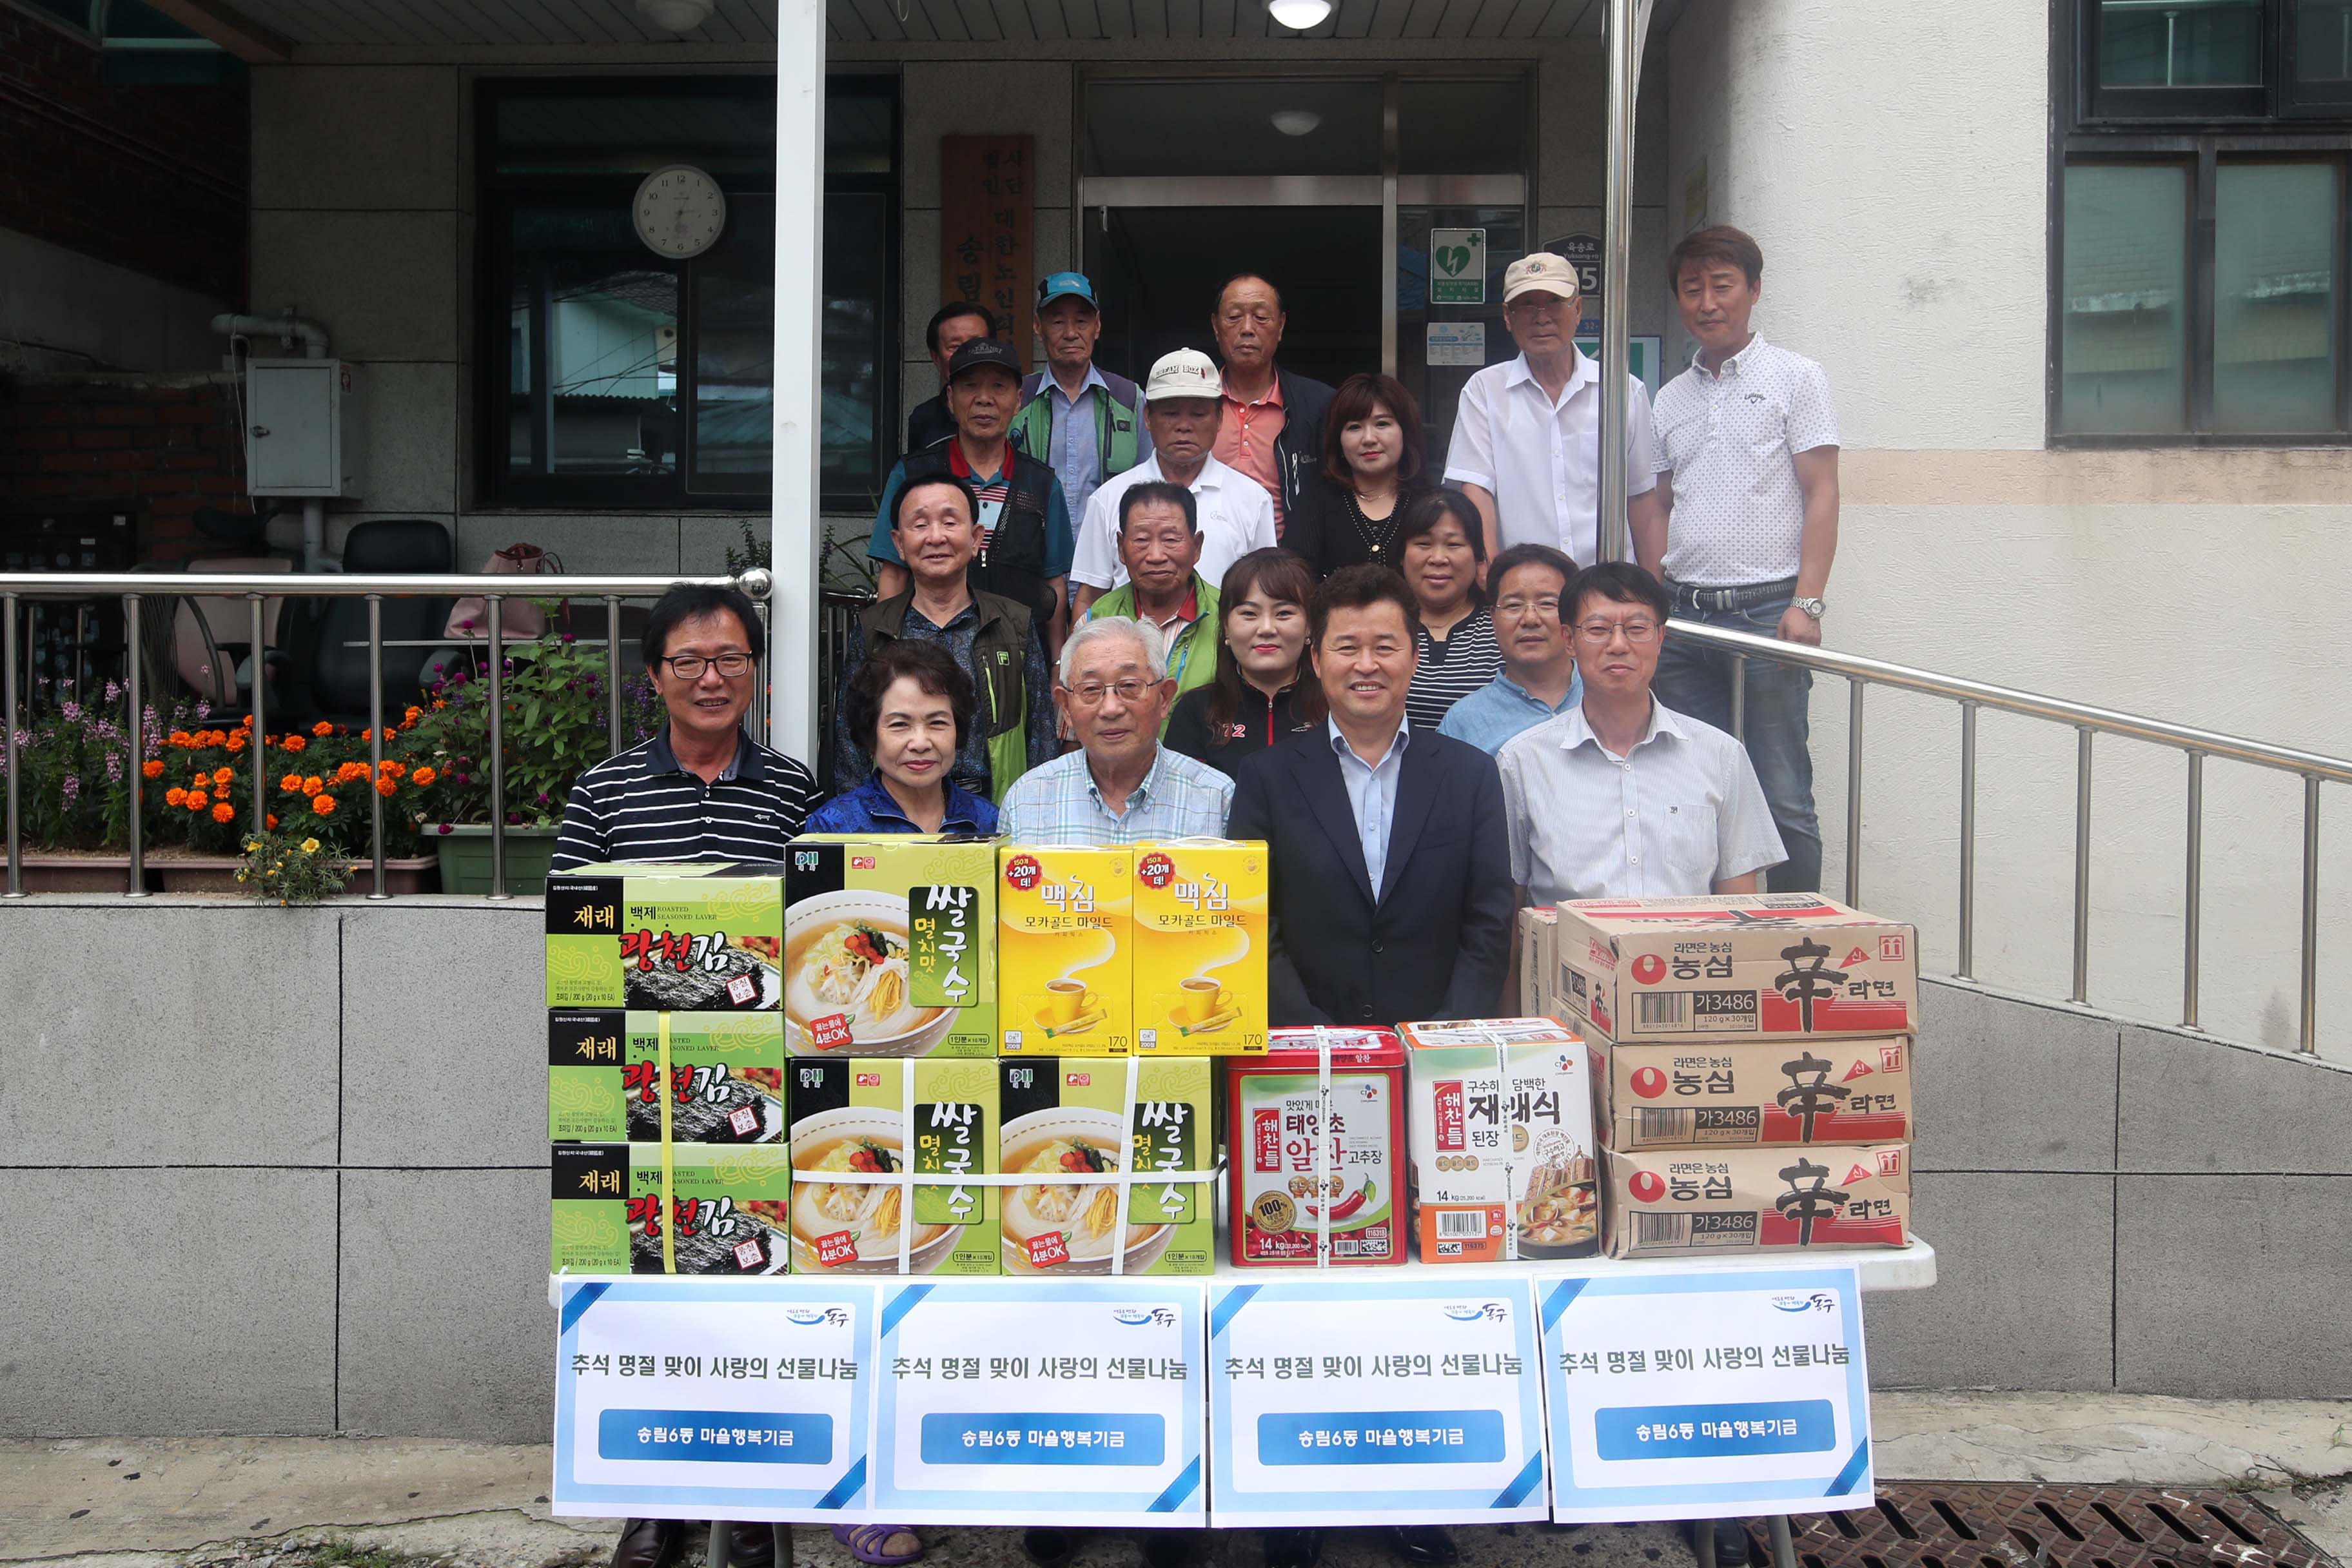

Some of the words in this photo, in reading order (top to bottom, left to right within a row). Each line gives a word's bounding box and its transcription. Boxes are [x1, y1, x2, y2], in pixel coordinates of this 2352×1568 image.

[1182, 365, 1199, 375] BOX
[1141, 864, 1170, 877] +20개
[1146, 857, 1162, 865] 150개
[1008, 865, 1036, 878] +20개
[1019, 877, 1032, 888] 더!
[1153, 876, 1164, 887] 더!
[1041, 875, 1095, 913] 맥심
[1174, 873, 1229, 912] 맥심
[573, 905, 614, 929] 재래
[631, 906, 656, 921] 백제
[1025, 917, 1072, 929] 모카골드
[1077, 916, 1114, 930] 마일드
[1159, 914, 1207, 927] 모카골드
[1211, 914, 1248, 927] 마일드
[619, 929, 729, 972] 광천김
[914, 917, 936, 974] 멸치맛
[926, 884, 972, 1003] 쌀국수
[1674, 943, 1707, 953] 라면은
[1710, 942, 1732, 952] 농심
[1851, 951, 1863, 961] 신
[1672, 956, 1733, 981] 농심
[1775, 936, 1849, 1033] 辛
[1848, 979, 1896, 1000] 라면
[1696, 995, 1754, 1012] 가3486
[815, 1019, 842, 1032] 끓는물에
[633, 1037, 658, 1052] 백제
[815, 1027, 849, 1045] 4분OK
[1108, 1035, 1128, 1048] 170
[1243, 1034, 1263, 1046] 170
[575, 1036, 616, 1061] 재래
[1355, 1054, 1370, 1063] 알찬
[1674, 1057, 1707, 1068] 라면은
[1709, 1057, 1732, 1067] 농심
[1854, 1064, 1865, 1075] 신
[621, 1061, 731, 1103] 광천김
[1512, 1078, 1546, 1092] 담백한
[1672, 1070, 1734, 1095] 농심
[1286, 1100, 1313, 1112] 맛있게
[1777, 1051, 1852, 1143] 辛
[1850, 1093, 1896, 1114] 라면
[1443, 1092, 1463, 1145] 해찬들
[1698, 1109, 1757, 1127] 가3486
[1261, 1119, 1279, 1167] 해찬들
[1472, 1131, 1500, 1148] 된장
[931, 1101, 977, 1220] 쌀국수
[1142, 1100, 1188, 1220] 쌀국수
[1348, 1151, 1382, 1164] 고추장
[636, 1170, 662, 1185] 백제
[1669, 1164, 1703, 1175] 라면은
[1705, 1163, 1729, 1174] 농심
[1852, 1168, 1865, 1179] 신
[579, 1170, 620, 1194] 재래
[1669, 1175, 1733, 1202] 농심
[1437, 1191, 1449, 1201] 14
[1775, 1157, 1850, 1246] 辛
[625, 1193, 737, 1238] 광천김
[1849, 1199, 1892, 1220] 라면
[1696, 1214, 1754, 1231] 가3486
[820, 1235, 847, 1248] 끓는물에
[1032, 1235, 1058, 1250] 끓는물에
[1260, 1237, 1273, 1250] 14
[821, 1244, 854, 1262] 4분OK
[1032, 1244, 1065, 1263] 4분OK
[1482, 1303, 1508, 1322] 동구
[1810, 1294, 1836, 1313] 동구
[825, 1308, 850, 1328] 동구
[1150, 1308, 1176, 1328] 동구
[571, 1355, 610, 1377] 추석
[618, 1355, 656, 1377] 명절
[664, 1356, 701, 1378] 맞이
[710, 1357, 768, 1379] 사랑의
[776, 1358, 858, 1380] 선물나눔
[892, 1357, 932, 1380] 추석
[941, 1357, 981, 1380] 명절
[990, 1357, 1029, 1380] 맞이
[1038, 1357, 1098, 1380] 사랑의
[1106, 1357, 1188, 1380] 선물나눔
[1225, 1357, 1265, 1380] 추석
[1274, 1356, 1313, 1378] 명절
[1323, 1355, 1362, 1378] 맞이
[1371, 1355, 1432, 1377] 사랑의
[1440, 1353, 1522, 1377] 선물나눔
[1559, 1351, 1600, 1375] 추석
[1607, 1350, 1647, 1373] 명절
[1654, 1349, 1694, 1371] 맞이
[1703, 1346, 1763, 1370] 사랑의
[1772, 1344, 1850, 1367] 선물나눔
[638, 1427, 694, 1444] 송림6동
[700, 1428, 794, 1446] 마을행복기금
[961, 1429, 1021, 1448] 송림6동
[1028, 1429, 1125, 1448] 마을행복기금
[1298, 1429, 1358, 1447] 송림6동
[1366, 1428, 1465, 1447] 마을행복기금
[1635, 1423, 1694, 1442] 송림6동
[1701, 1418, 1798, 1439] 마을행복기금
